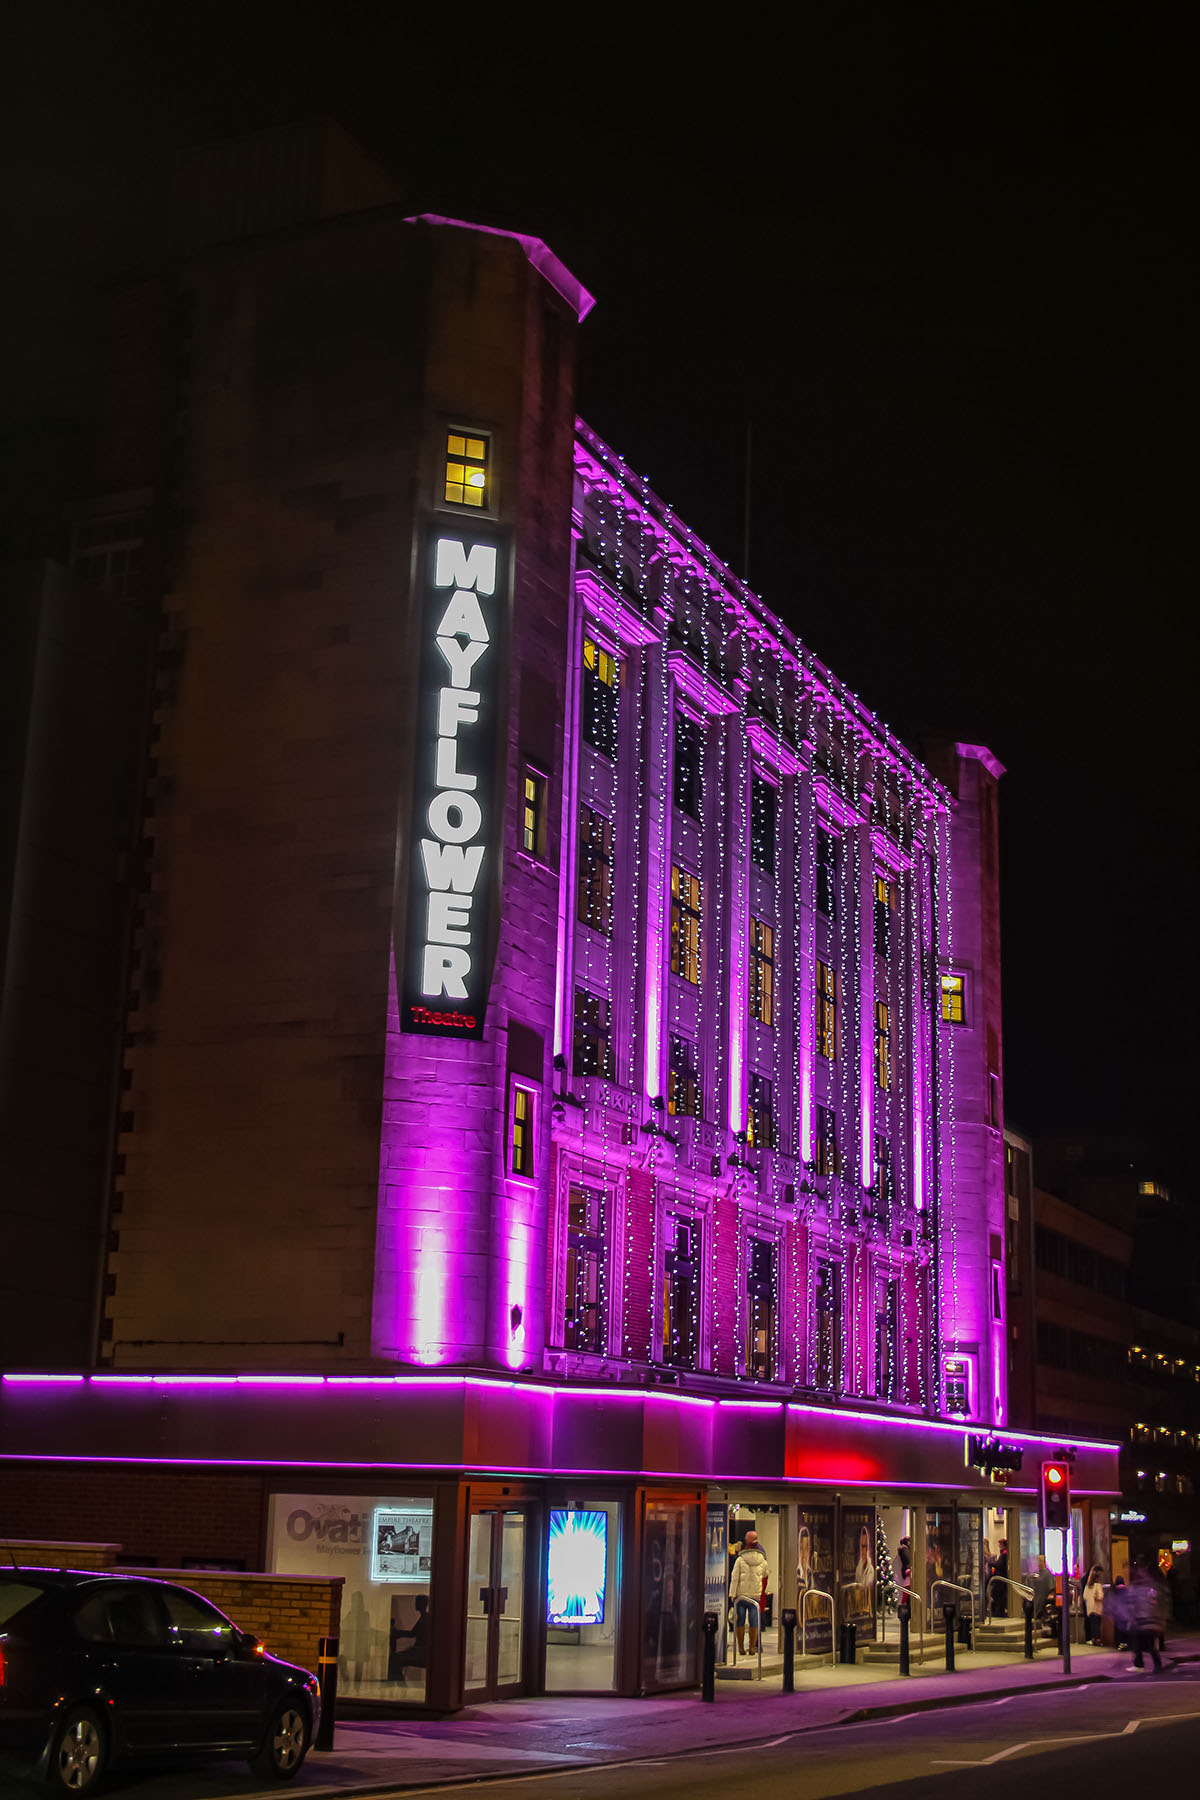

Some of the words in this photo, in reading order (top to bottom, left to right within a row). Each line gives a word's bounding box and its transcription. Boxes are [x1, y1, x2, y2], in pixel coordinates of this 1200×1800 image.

[419, 537, 498, 999] MAYFLOWER
[410, 1006, 477, 1029] Theatre
[378, 1516, 401, 1524] EMPIRE
[402, 1516, 429, 1524] THEATRE
